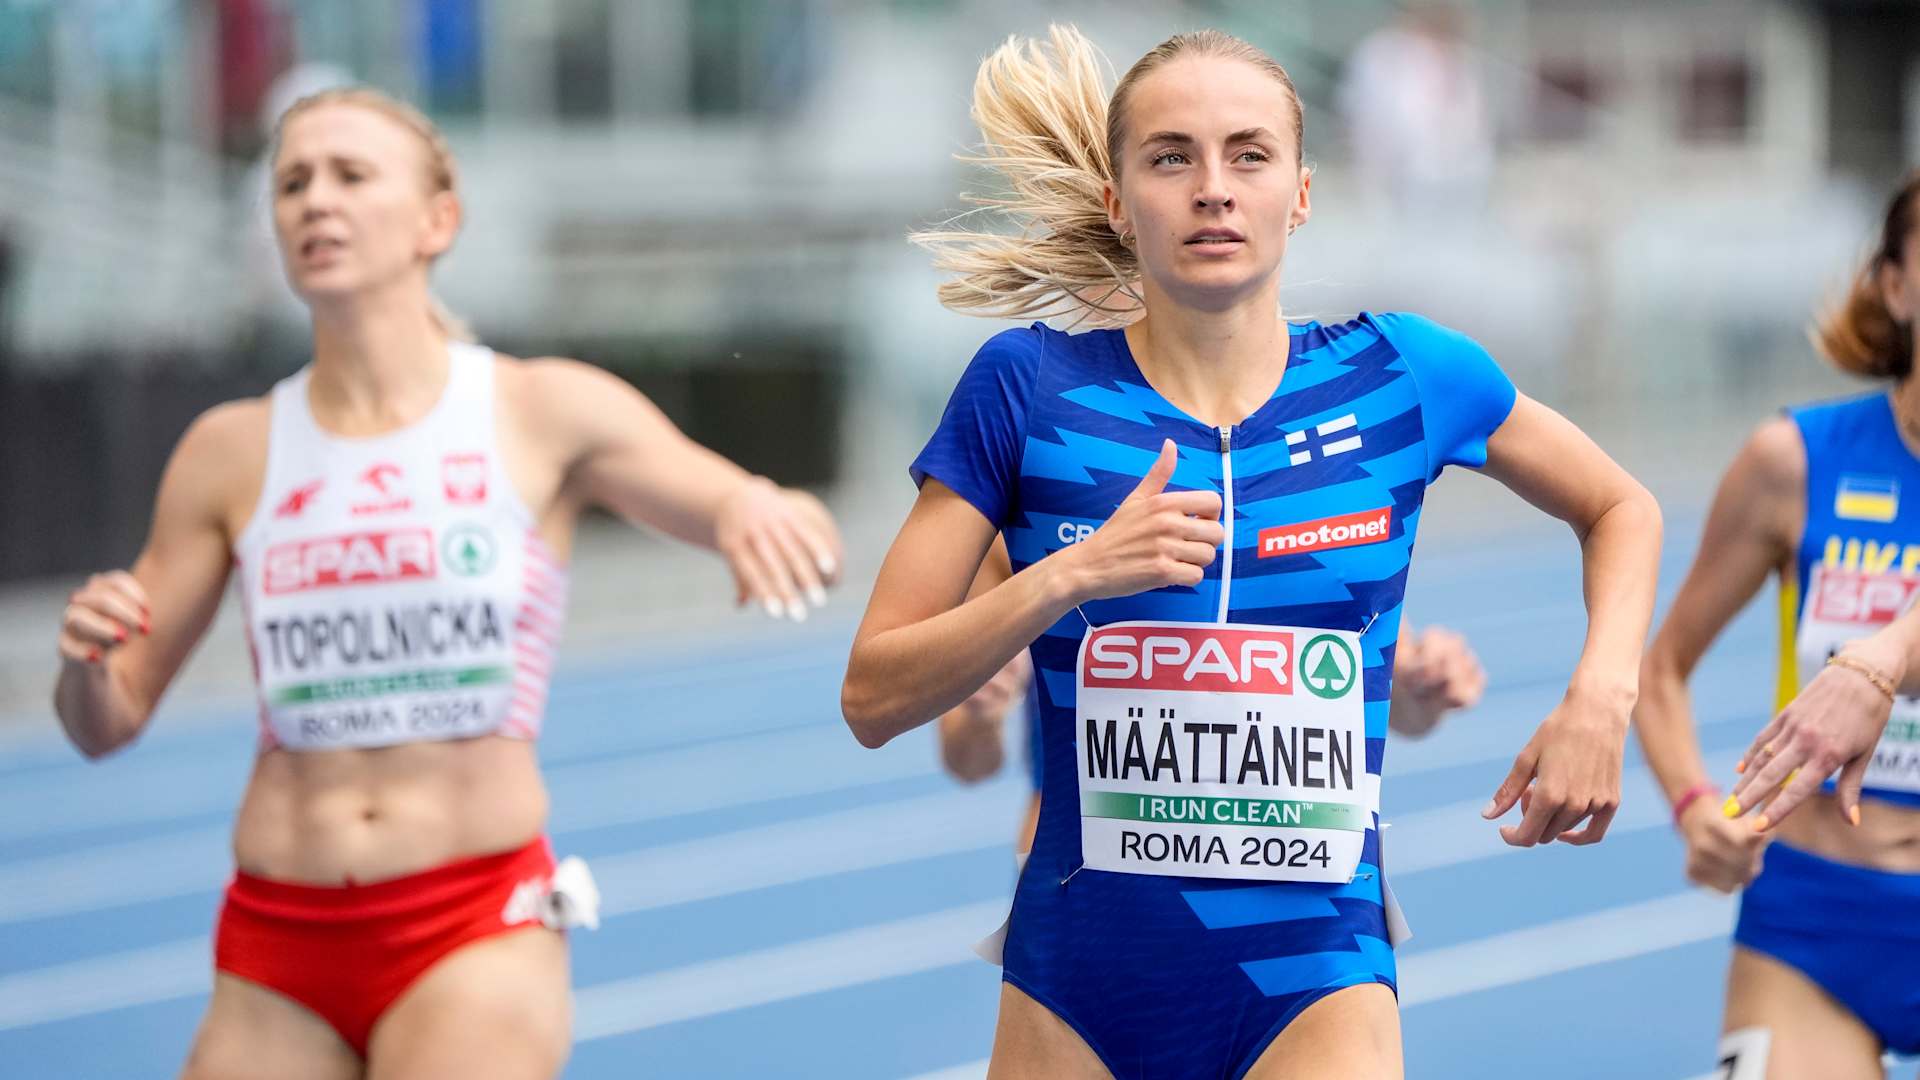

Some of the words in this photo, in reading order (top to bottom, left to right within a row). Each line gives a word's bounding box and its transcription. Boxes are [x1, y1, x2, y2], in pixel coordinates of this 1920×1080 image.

[1058, 522, 1095, 544] CR
[1265, 515, 1387, 551] motonet
[269, 532, 433, 592] SPAR
[265, 600, 501, 671] TOPOLNICKA
[1090, 635, 1288, 685] SPAR
[1086, 707, 1353, 790] MÄÄTTÄNEN
[1139, 797, 1145, 817] I
[1151, 798, 1206, 820] RUN
[1121, 831, 1230, 865] ROMA
[1240, 837, 1332, 868] 2024
